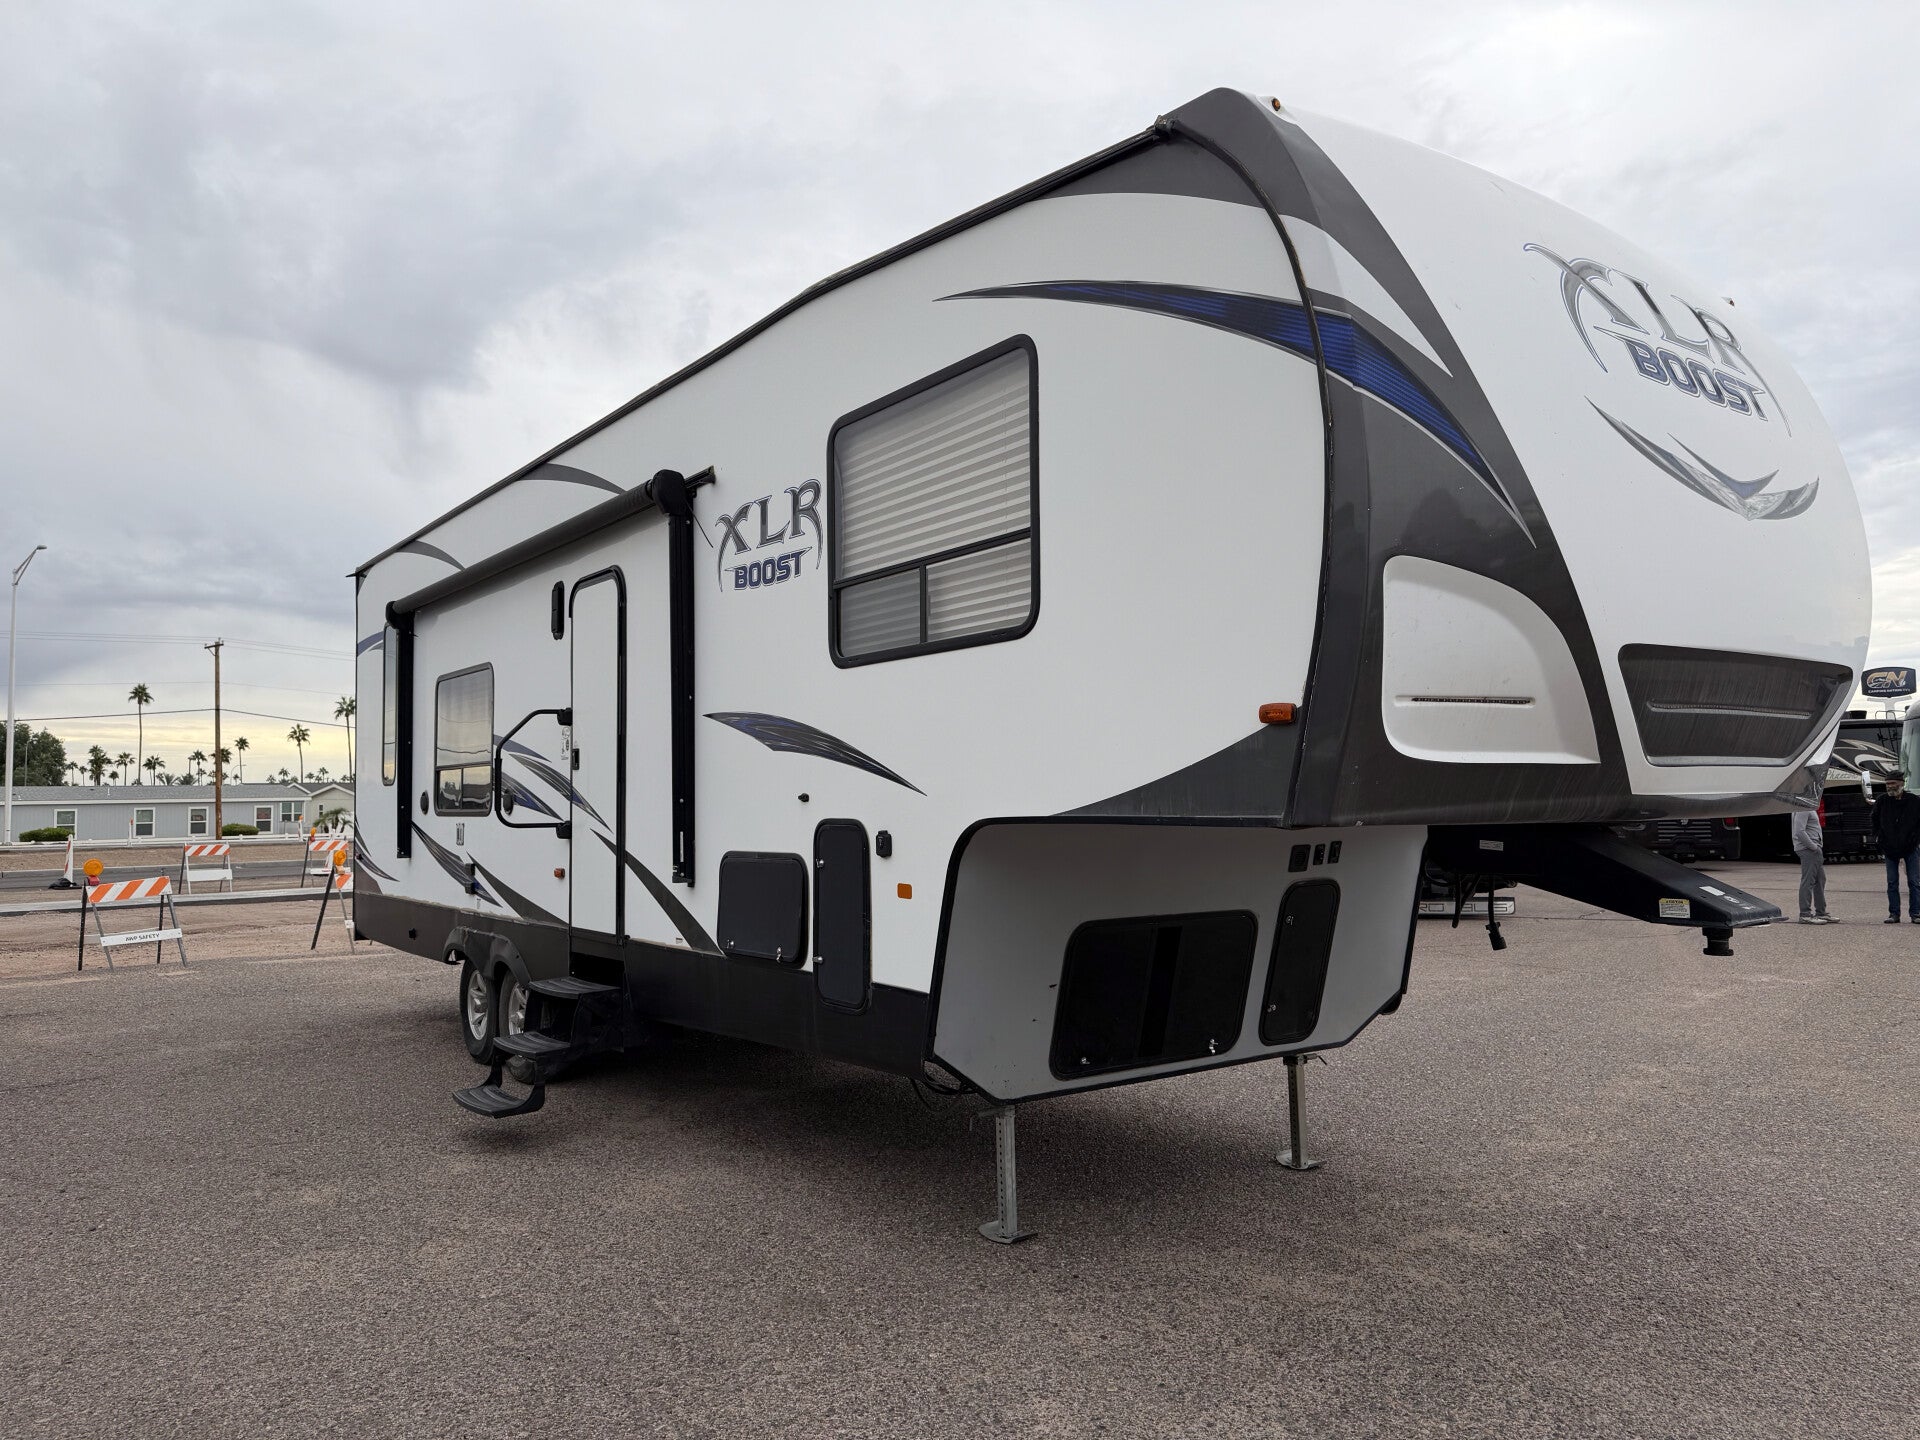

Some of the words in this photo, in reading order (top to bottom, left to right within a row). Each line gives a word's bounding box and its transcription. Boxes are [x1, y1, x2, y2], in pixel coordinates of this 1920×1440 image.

[1524, 244, 1791, 437] XLR
[1594, 325, 1768, 421] BOOST
[715, 479, 823, 591] XLR
[725, 547, 812, 590] BOOST
[1824, 854, 1886, 862] HAETON
